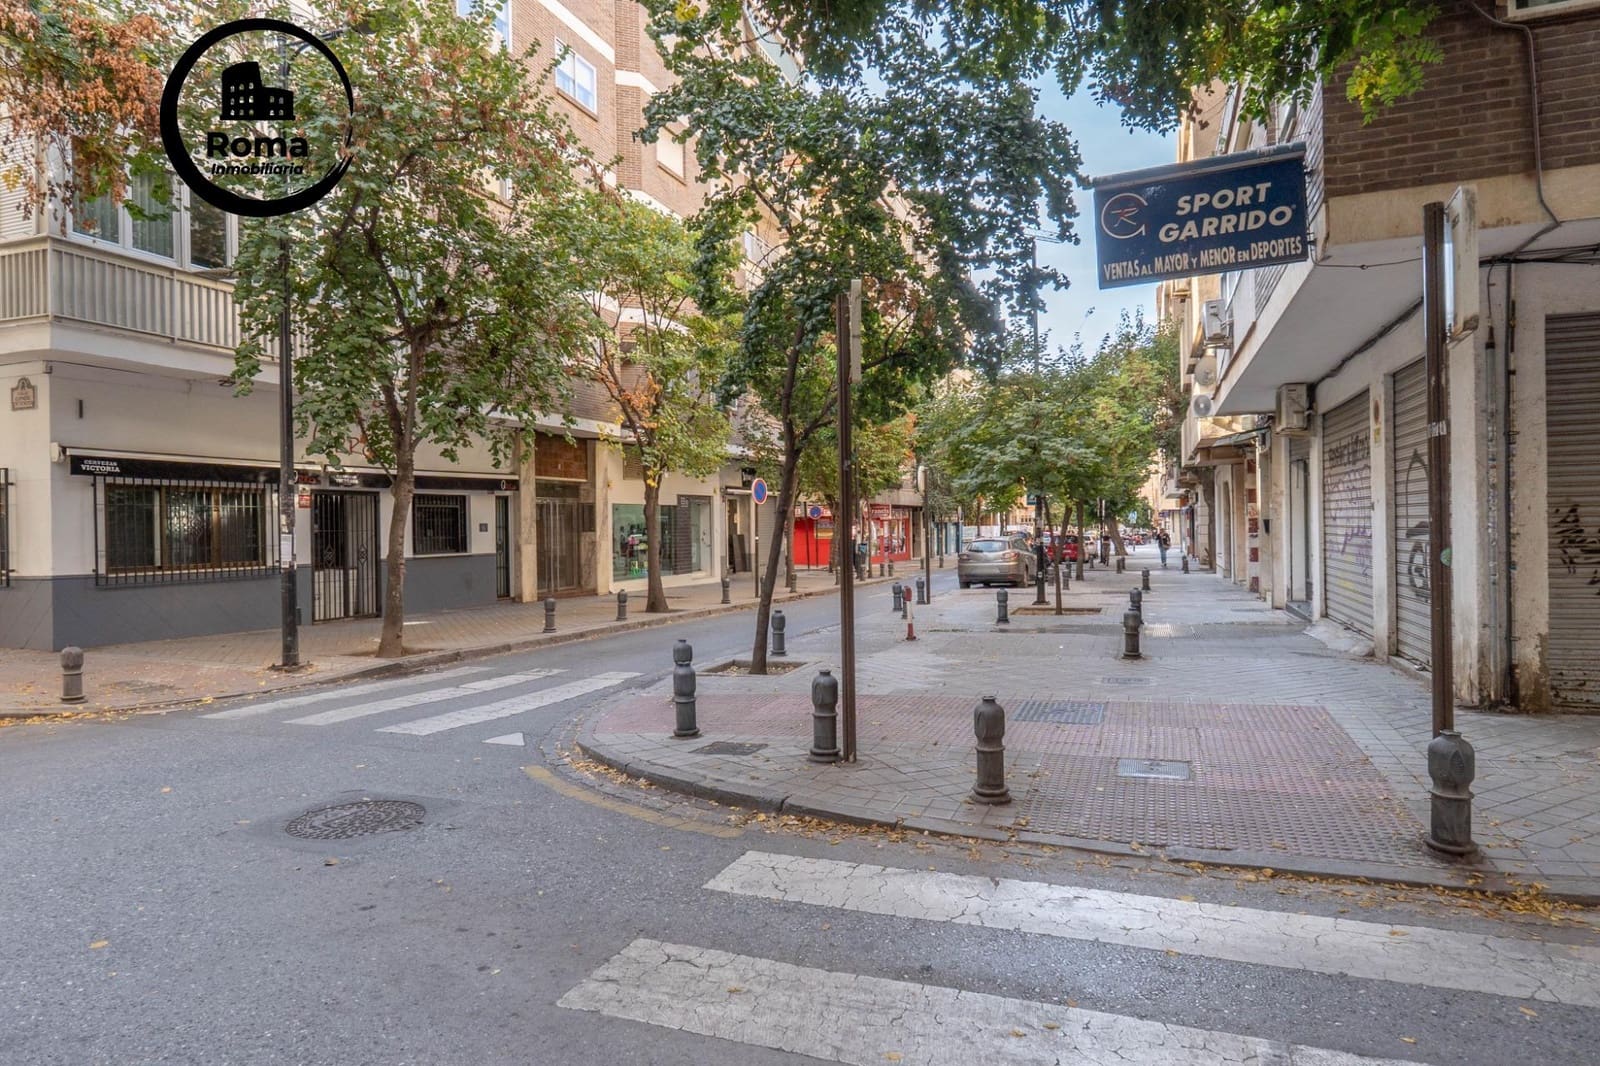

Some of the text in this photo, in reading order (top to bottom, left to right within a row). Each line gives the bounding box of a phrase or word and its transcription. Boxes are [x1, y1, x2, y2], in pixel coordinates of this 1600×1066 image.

[1176, 182, 1272, 216] SPORT
[1159, 205, 1293, 243] GARRIDO
[1104, 236, 1302, 280] VENTAS AL MAYOR Y MENOR EN DEPORTES
[80, 464, 121, 473] VICTORIA
